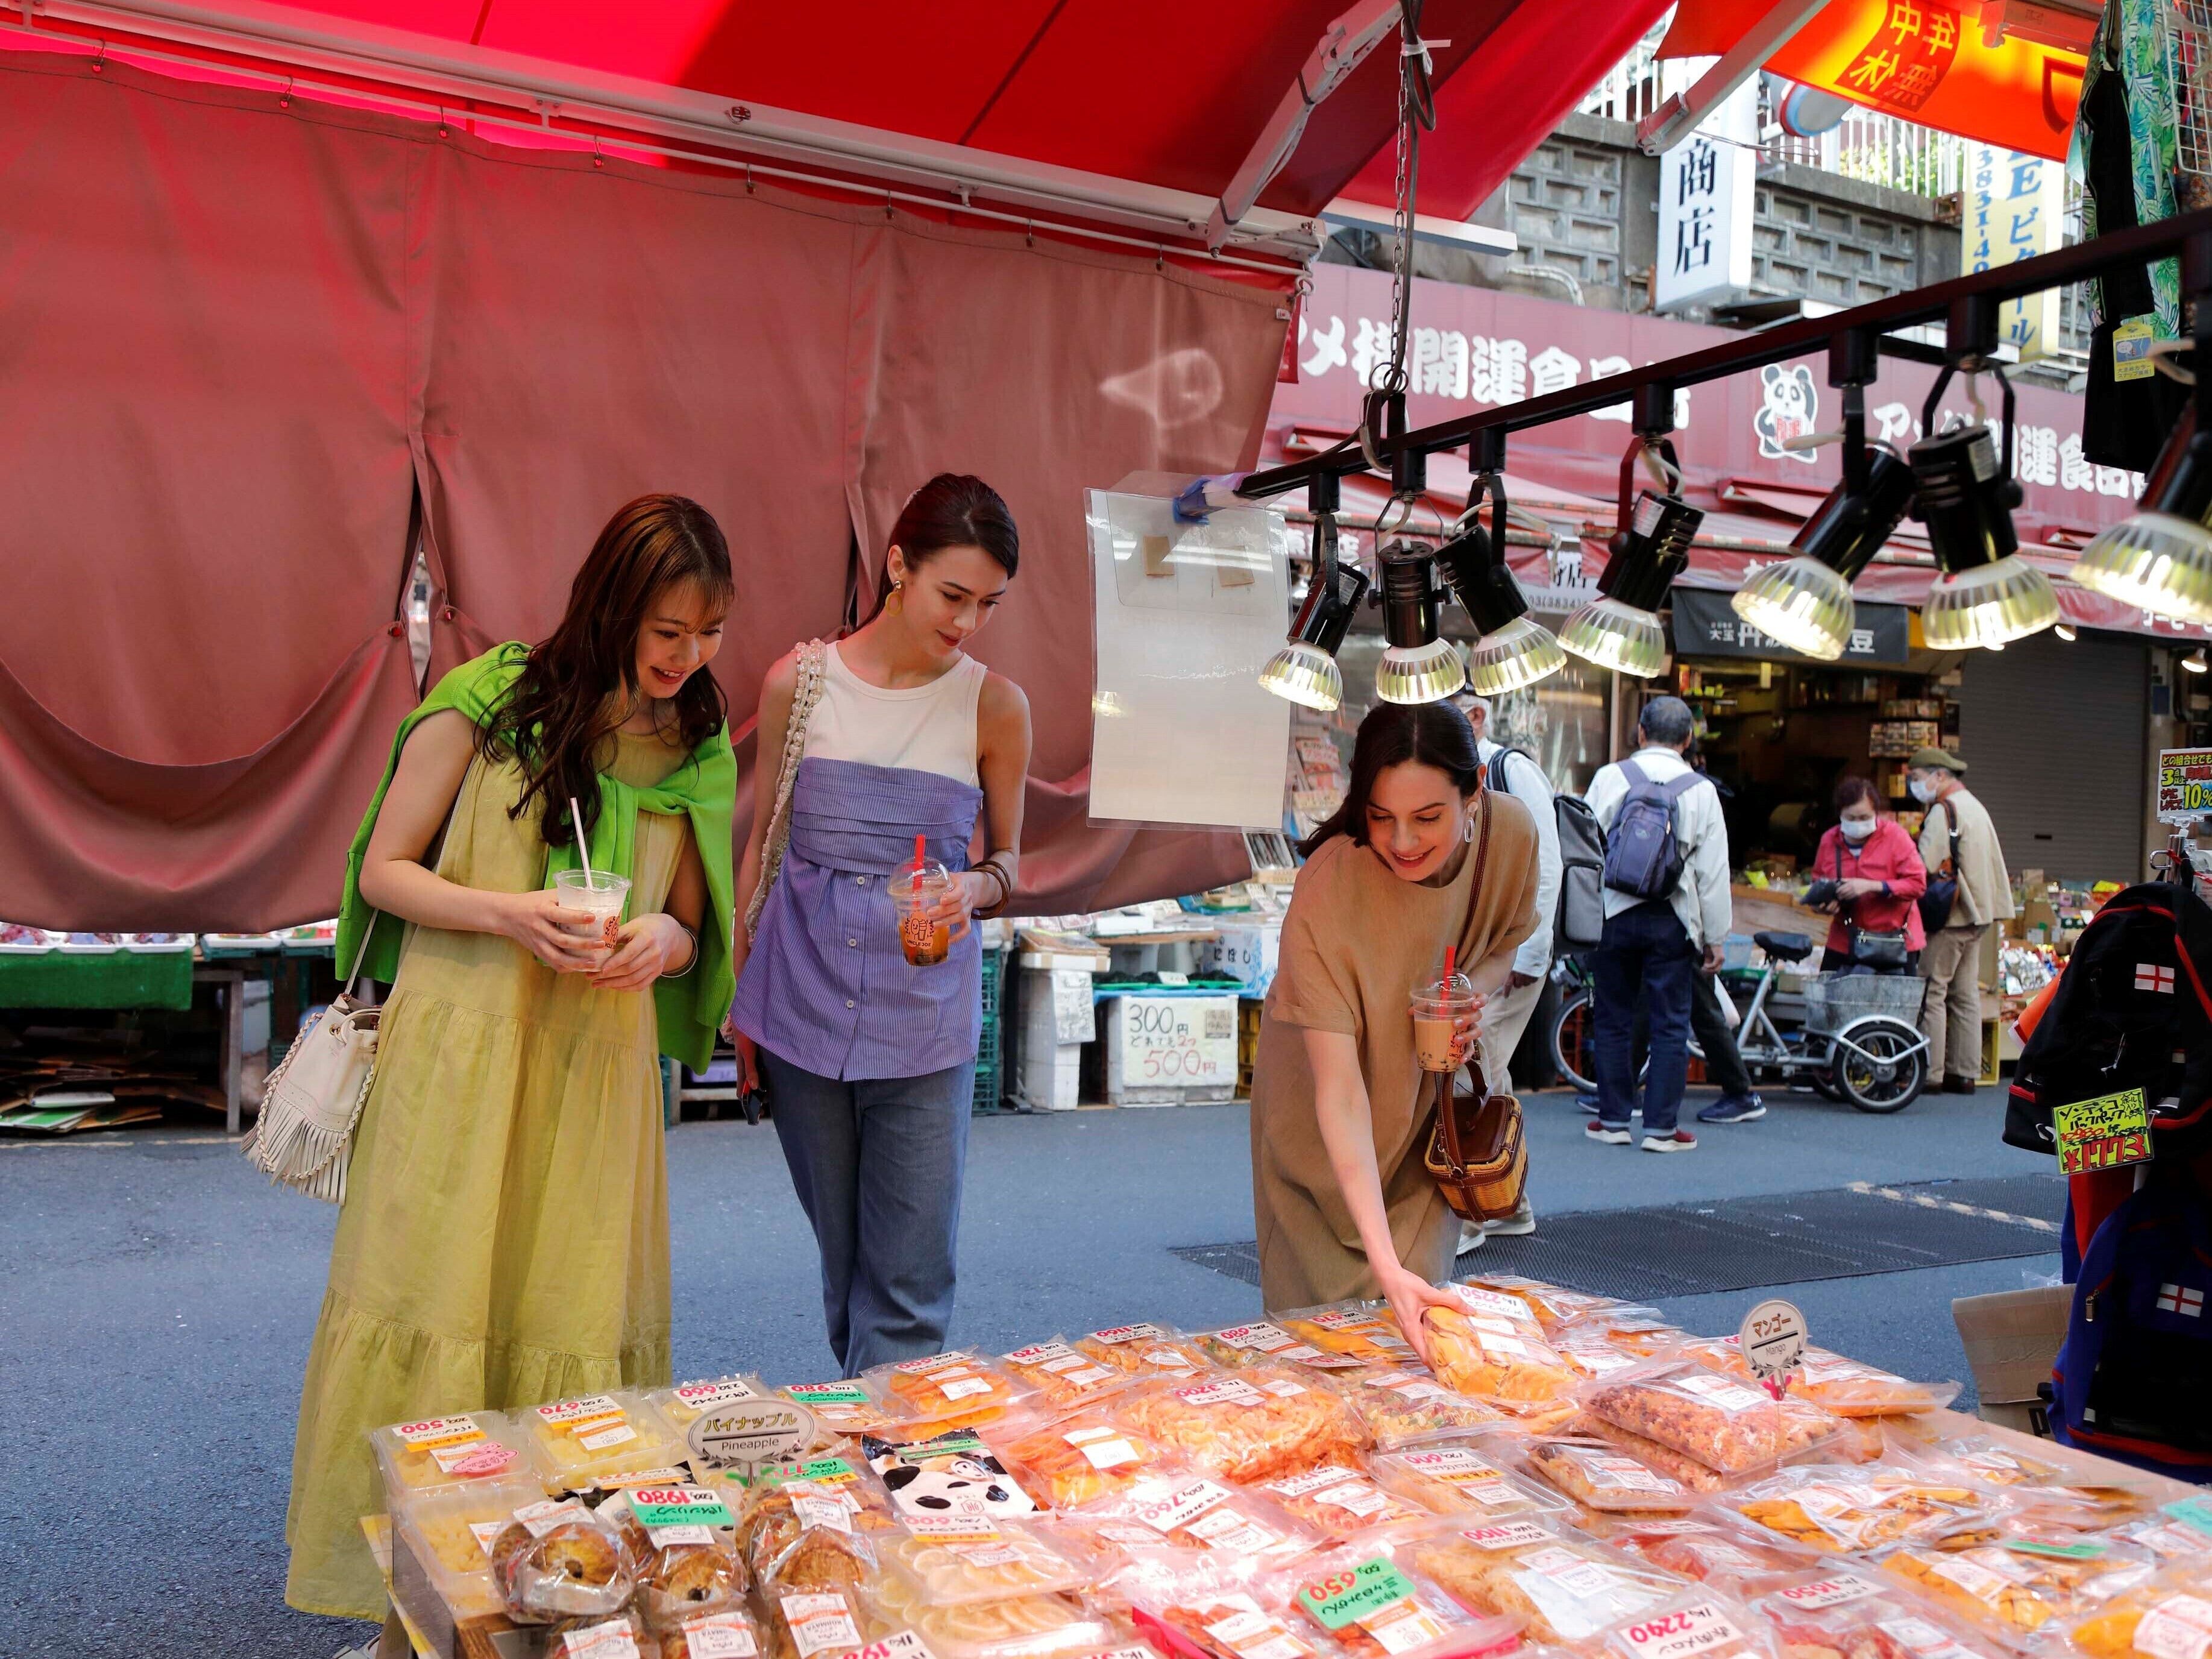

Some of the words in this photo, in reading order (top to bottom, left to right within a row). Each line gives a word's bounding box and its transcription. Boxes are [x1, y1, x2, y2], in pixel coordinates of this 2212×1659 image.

[1674, 137, 1717, 277] 商店
[1130, 1004, 1189, 1035] 300円
[1143, 1050, 1216, 1078] 500円
[1460, 1286, 1501, 1305] 2250
[1096, 1327, 1131, 1337] 1160
[1753, 1314, 1791, 1338] マンゴー
[1012, 1347, 1045, 1358] 720
[1766, 1343, 1785, 1356] Mango
[897, 1358, 932, 1369] 600
[679, 1386, 716, 1397] 660
[1175, 1384, 1222, 1397] 3200
[539, 1402, 579, 1414] 670
[401, 1420, 444, 1434] 500
[703, 1412, 797, 1433] パイナップル
[721, 1437, 779, 1451] Pineapple
[1404, 1453, 1442, 1464] 600
[636, 1491, 691, 1505] 1980
[1144, 1494, 1186, 1520] 760
[904, 1517, 950, 1525] 600
[1463, 1528, 1511, 1540] 1100
[1309, 1572, 1356, 1602] 650
[1782, 1582, 1841, 1599] 1650
